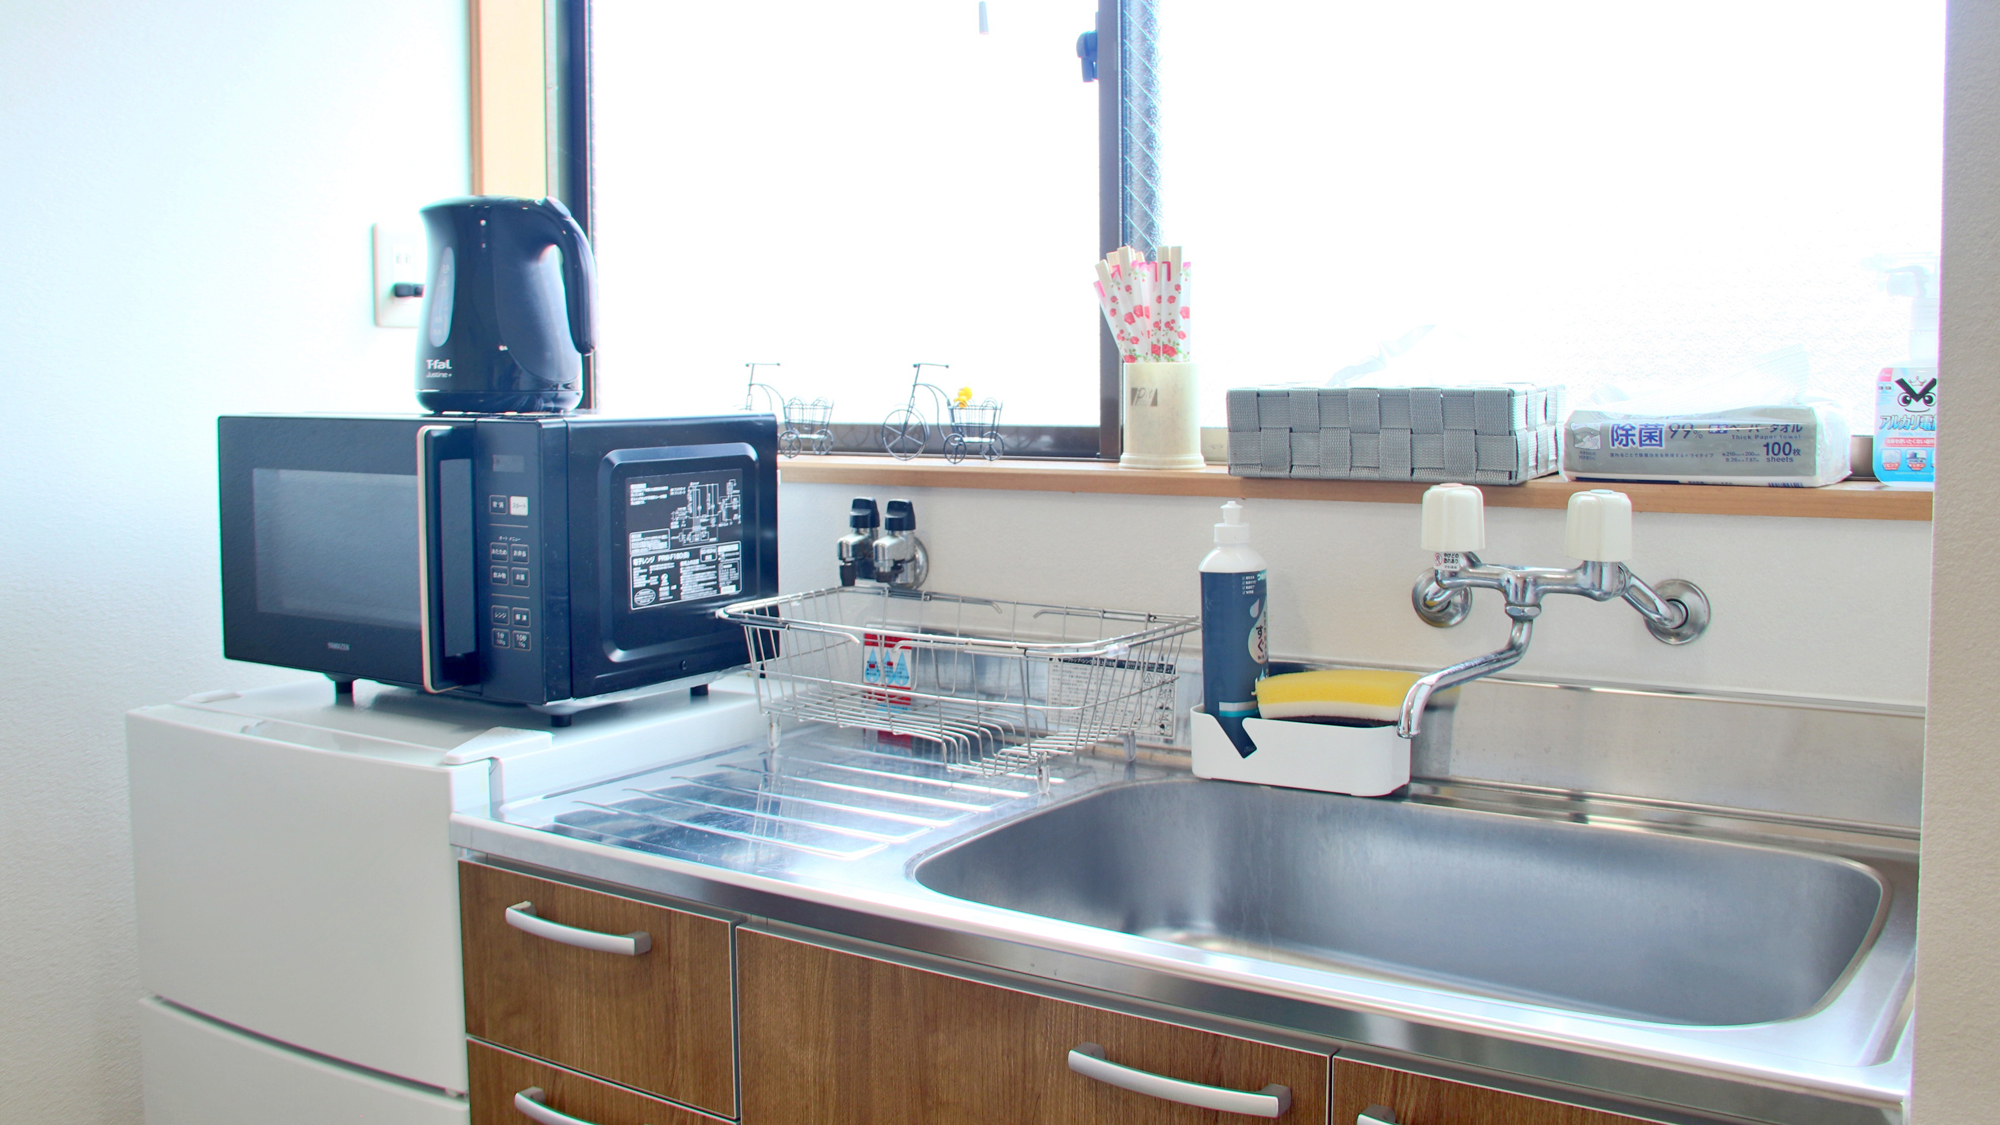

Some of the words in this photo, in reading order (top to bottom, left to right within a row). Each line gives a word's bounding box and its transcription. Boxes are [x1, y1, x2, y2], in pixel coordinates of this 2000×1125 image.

[1879, 414, 1936, 431] アルカリ電
[1610, 422, 1665, 448] 除菌
